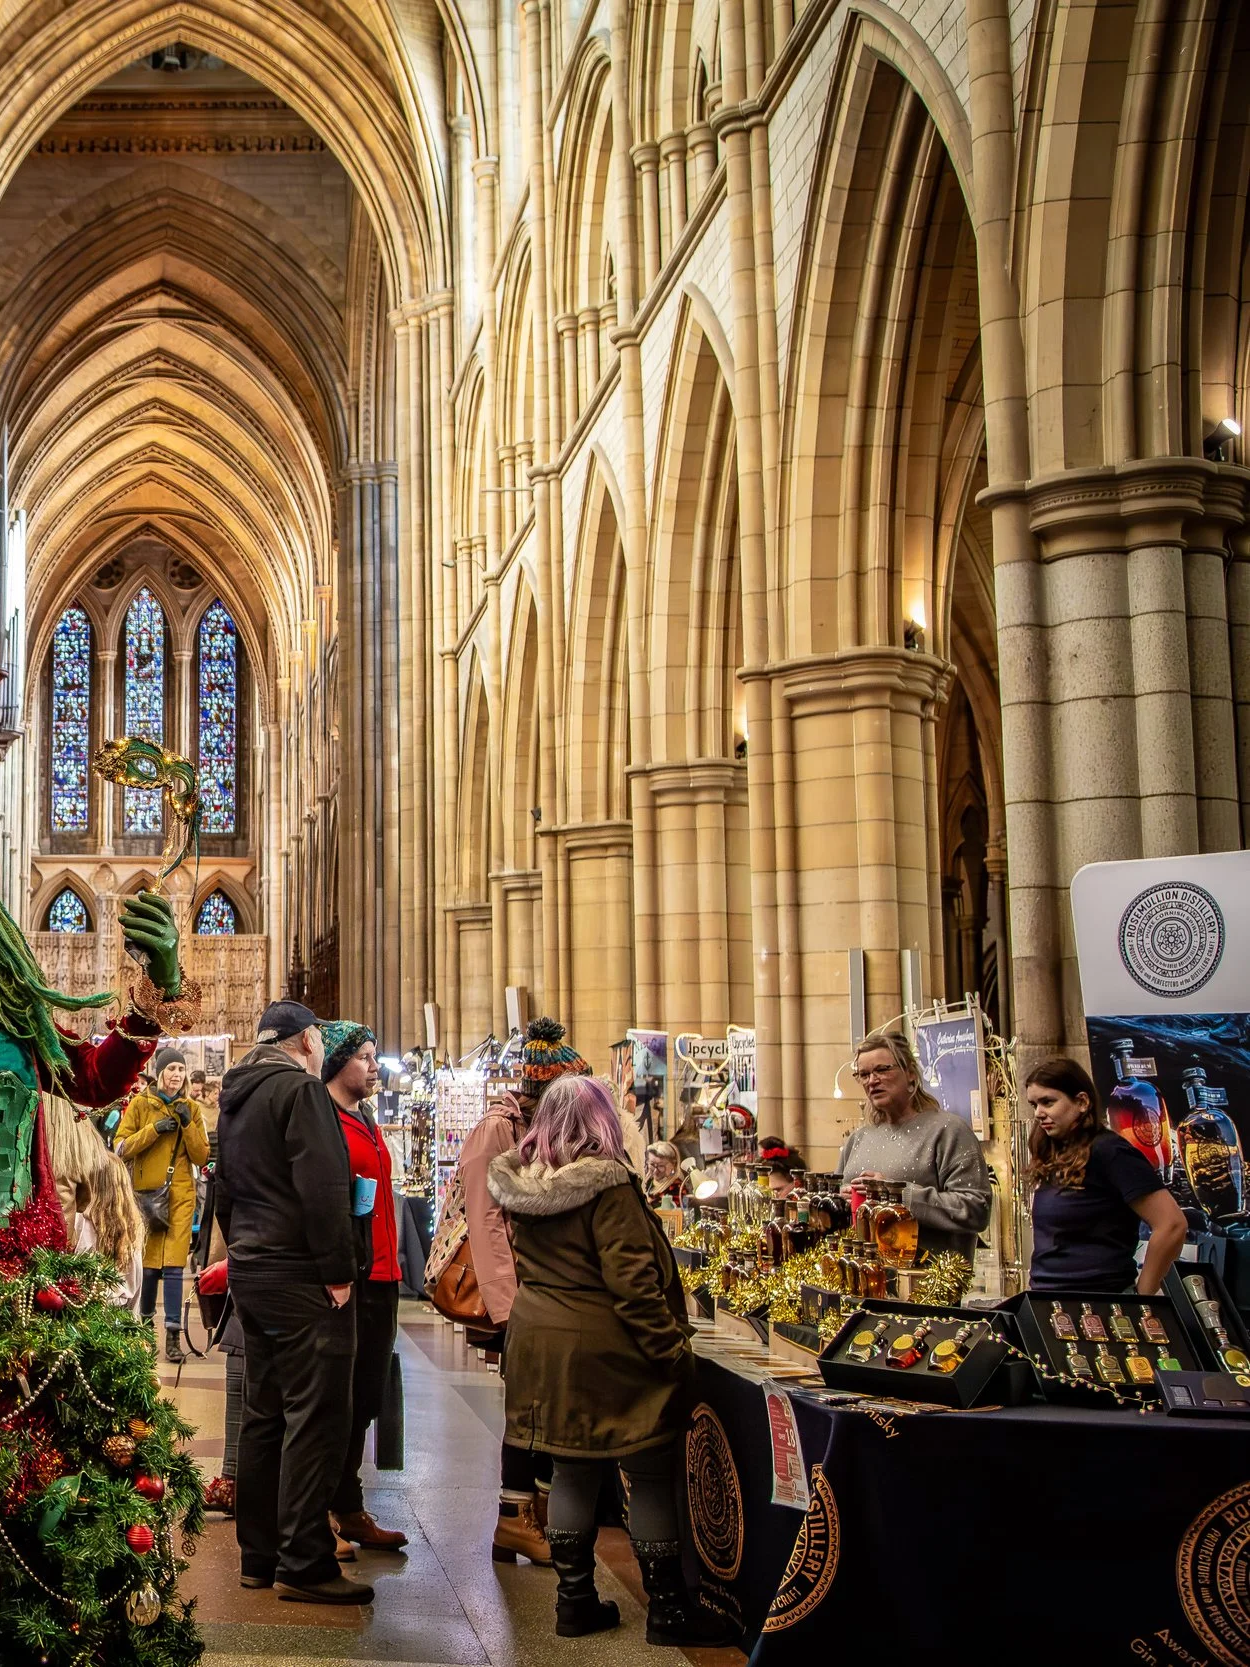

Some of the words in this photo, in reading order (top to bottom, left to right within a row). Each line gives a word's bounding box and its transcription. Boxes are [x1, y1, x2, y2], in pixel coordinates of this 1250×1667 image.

[1127, 890, 1179, 938] ROSEMULLION
[1181, 891, 1217, 934] DISTILLERY
[1155, 910, 1186, 921] CORNISH
[785, 1427, 796, 1448] 18
[864, 1409, 900, 1439] isky
[1220, 1499, 1250, 1527] RO
[801, 1499, 826, 1584] STILLERY
[1197, 1527, 1222, 1585] PROTECTORS
[776, 1586, 802, 1609] CRAFT
